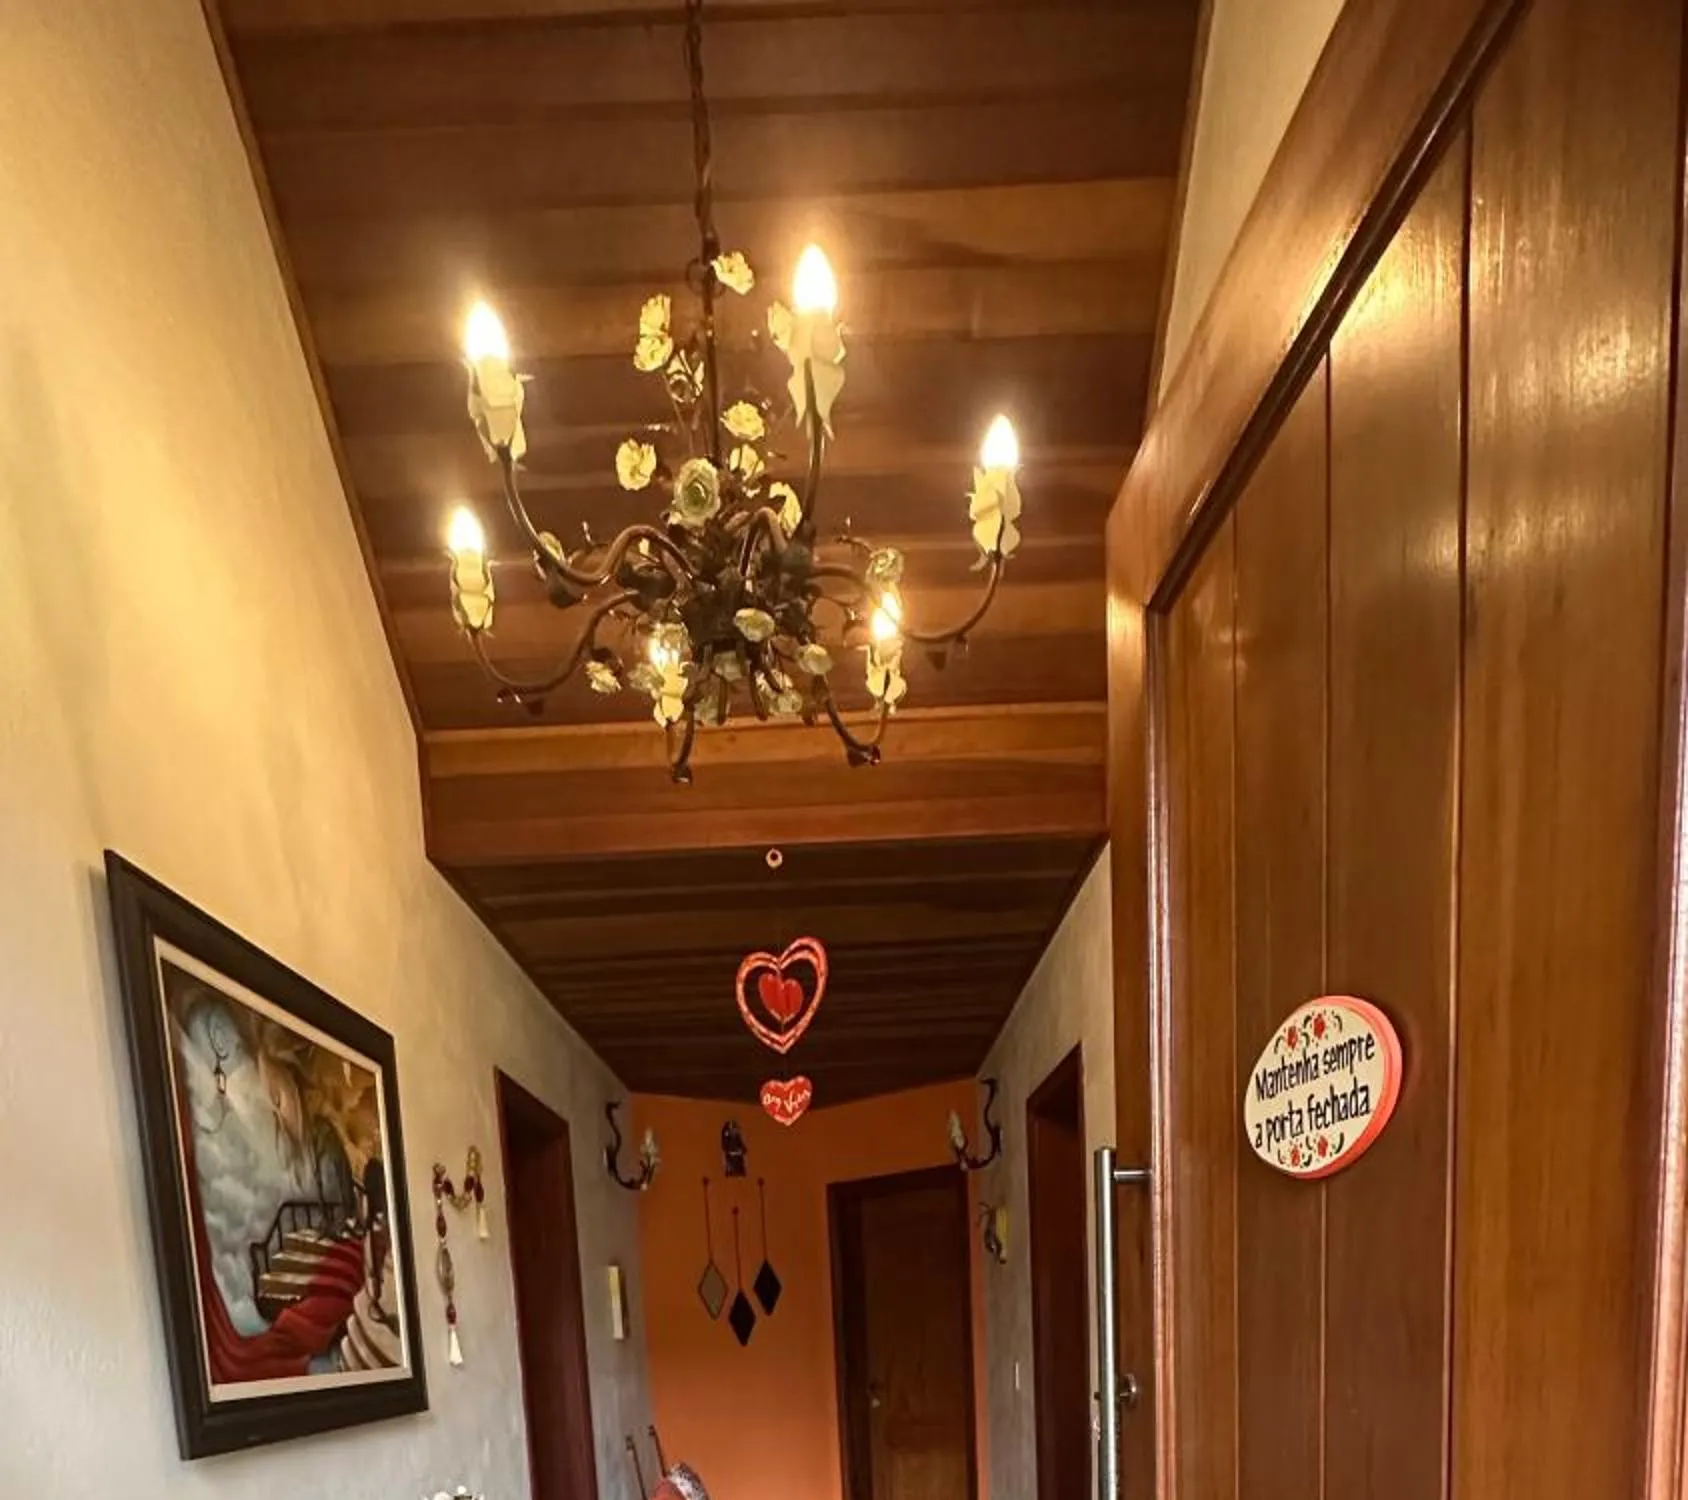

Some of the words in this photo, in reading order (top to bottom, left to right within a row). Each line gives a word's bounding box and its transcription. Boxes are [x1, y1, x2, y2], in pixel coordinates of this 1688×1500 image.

[1255, 1050, 1320, 1102] Mantenha
[1322, 1032, 1376, 1076] sempre
[1255, 1122, 1263, 1149] a
[1265, 1101, 1305, 1153] porta
[1307, 1077, 1371, 1132] fechada
